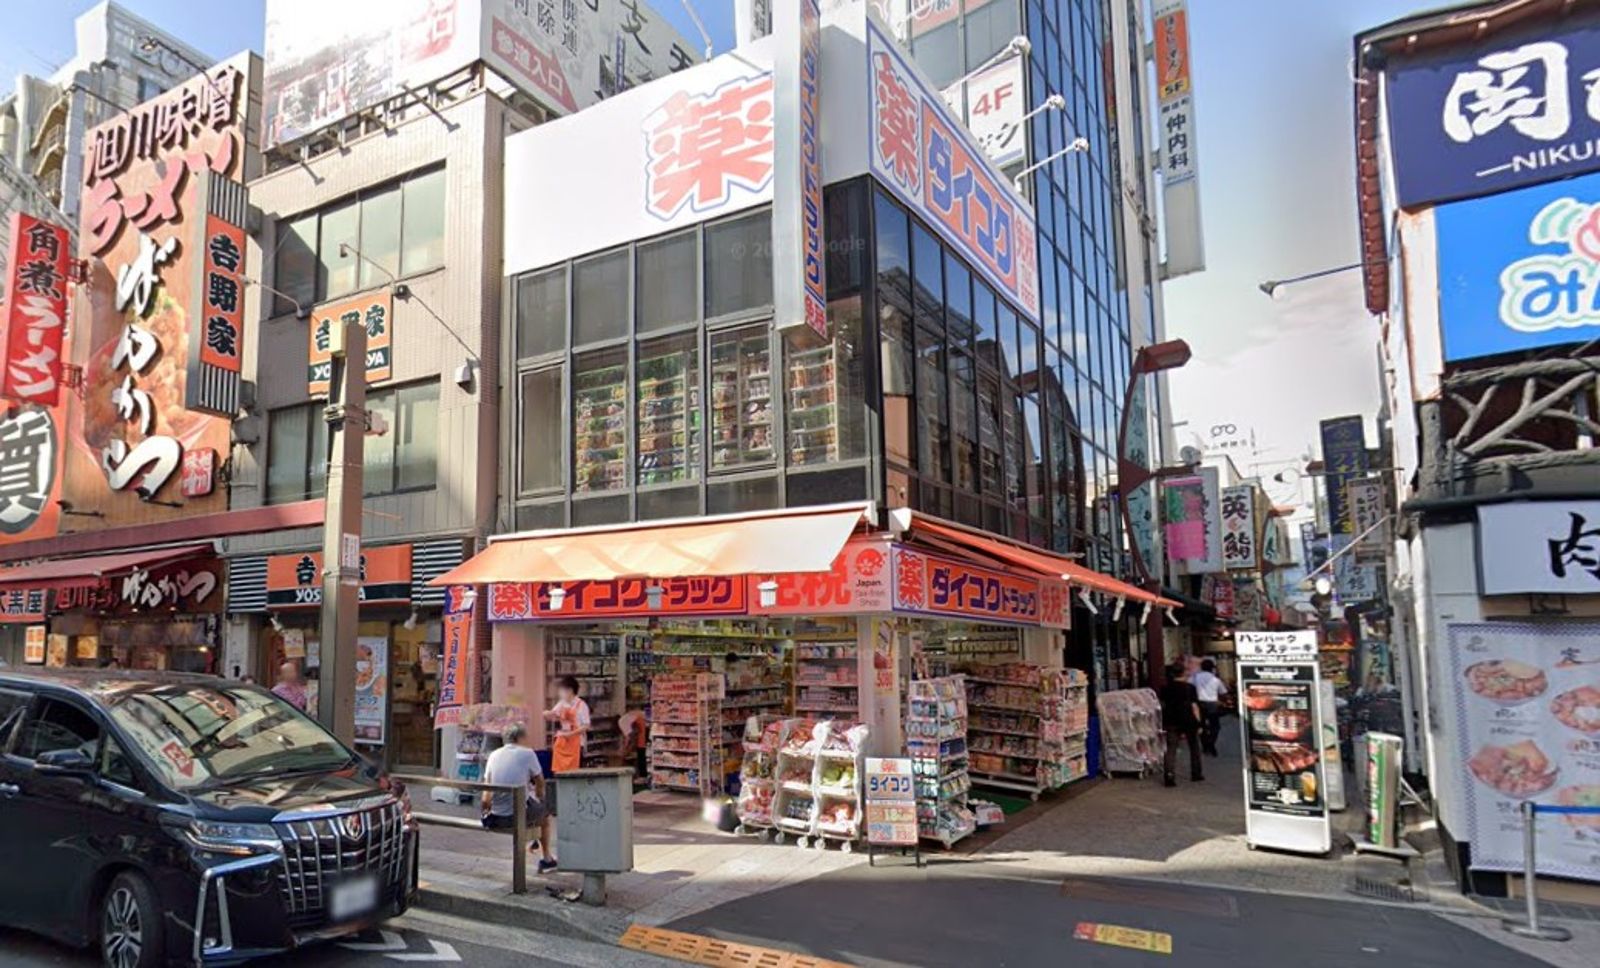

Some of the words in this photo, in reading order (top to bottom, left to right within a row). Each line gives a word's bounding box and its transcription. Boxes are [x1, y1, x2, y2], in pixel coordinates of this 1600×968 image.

[87, 65, 241, 184] 旭川味噌
[874, 53, 919, 194] 薬
[973, 82, 1013, 115] 4F
[650, 74, 774, 216] 薬
[87, 131, 238, 256] ラーメン
[928, 126, 1014, 276] ダイコク
[9, 221, 64, 398] 角煮ラーメン
[206, 234, 241, 357] 吉野家
[1522, 270, 1600, 318] み
[316, 304, 385, 351] 吉家
[1548, 512, 1600, 580] 肉
[0, 589, 43, 614] 黒屋
[537, 577, 732, 610] イコクラッグ
[898, 551, 923, 607] 薬
[932, 567, 1036, 616] ダイコクドラッグ
[870, 776, 910, 793] ダイコク
